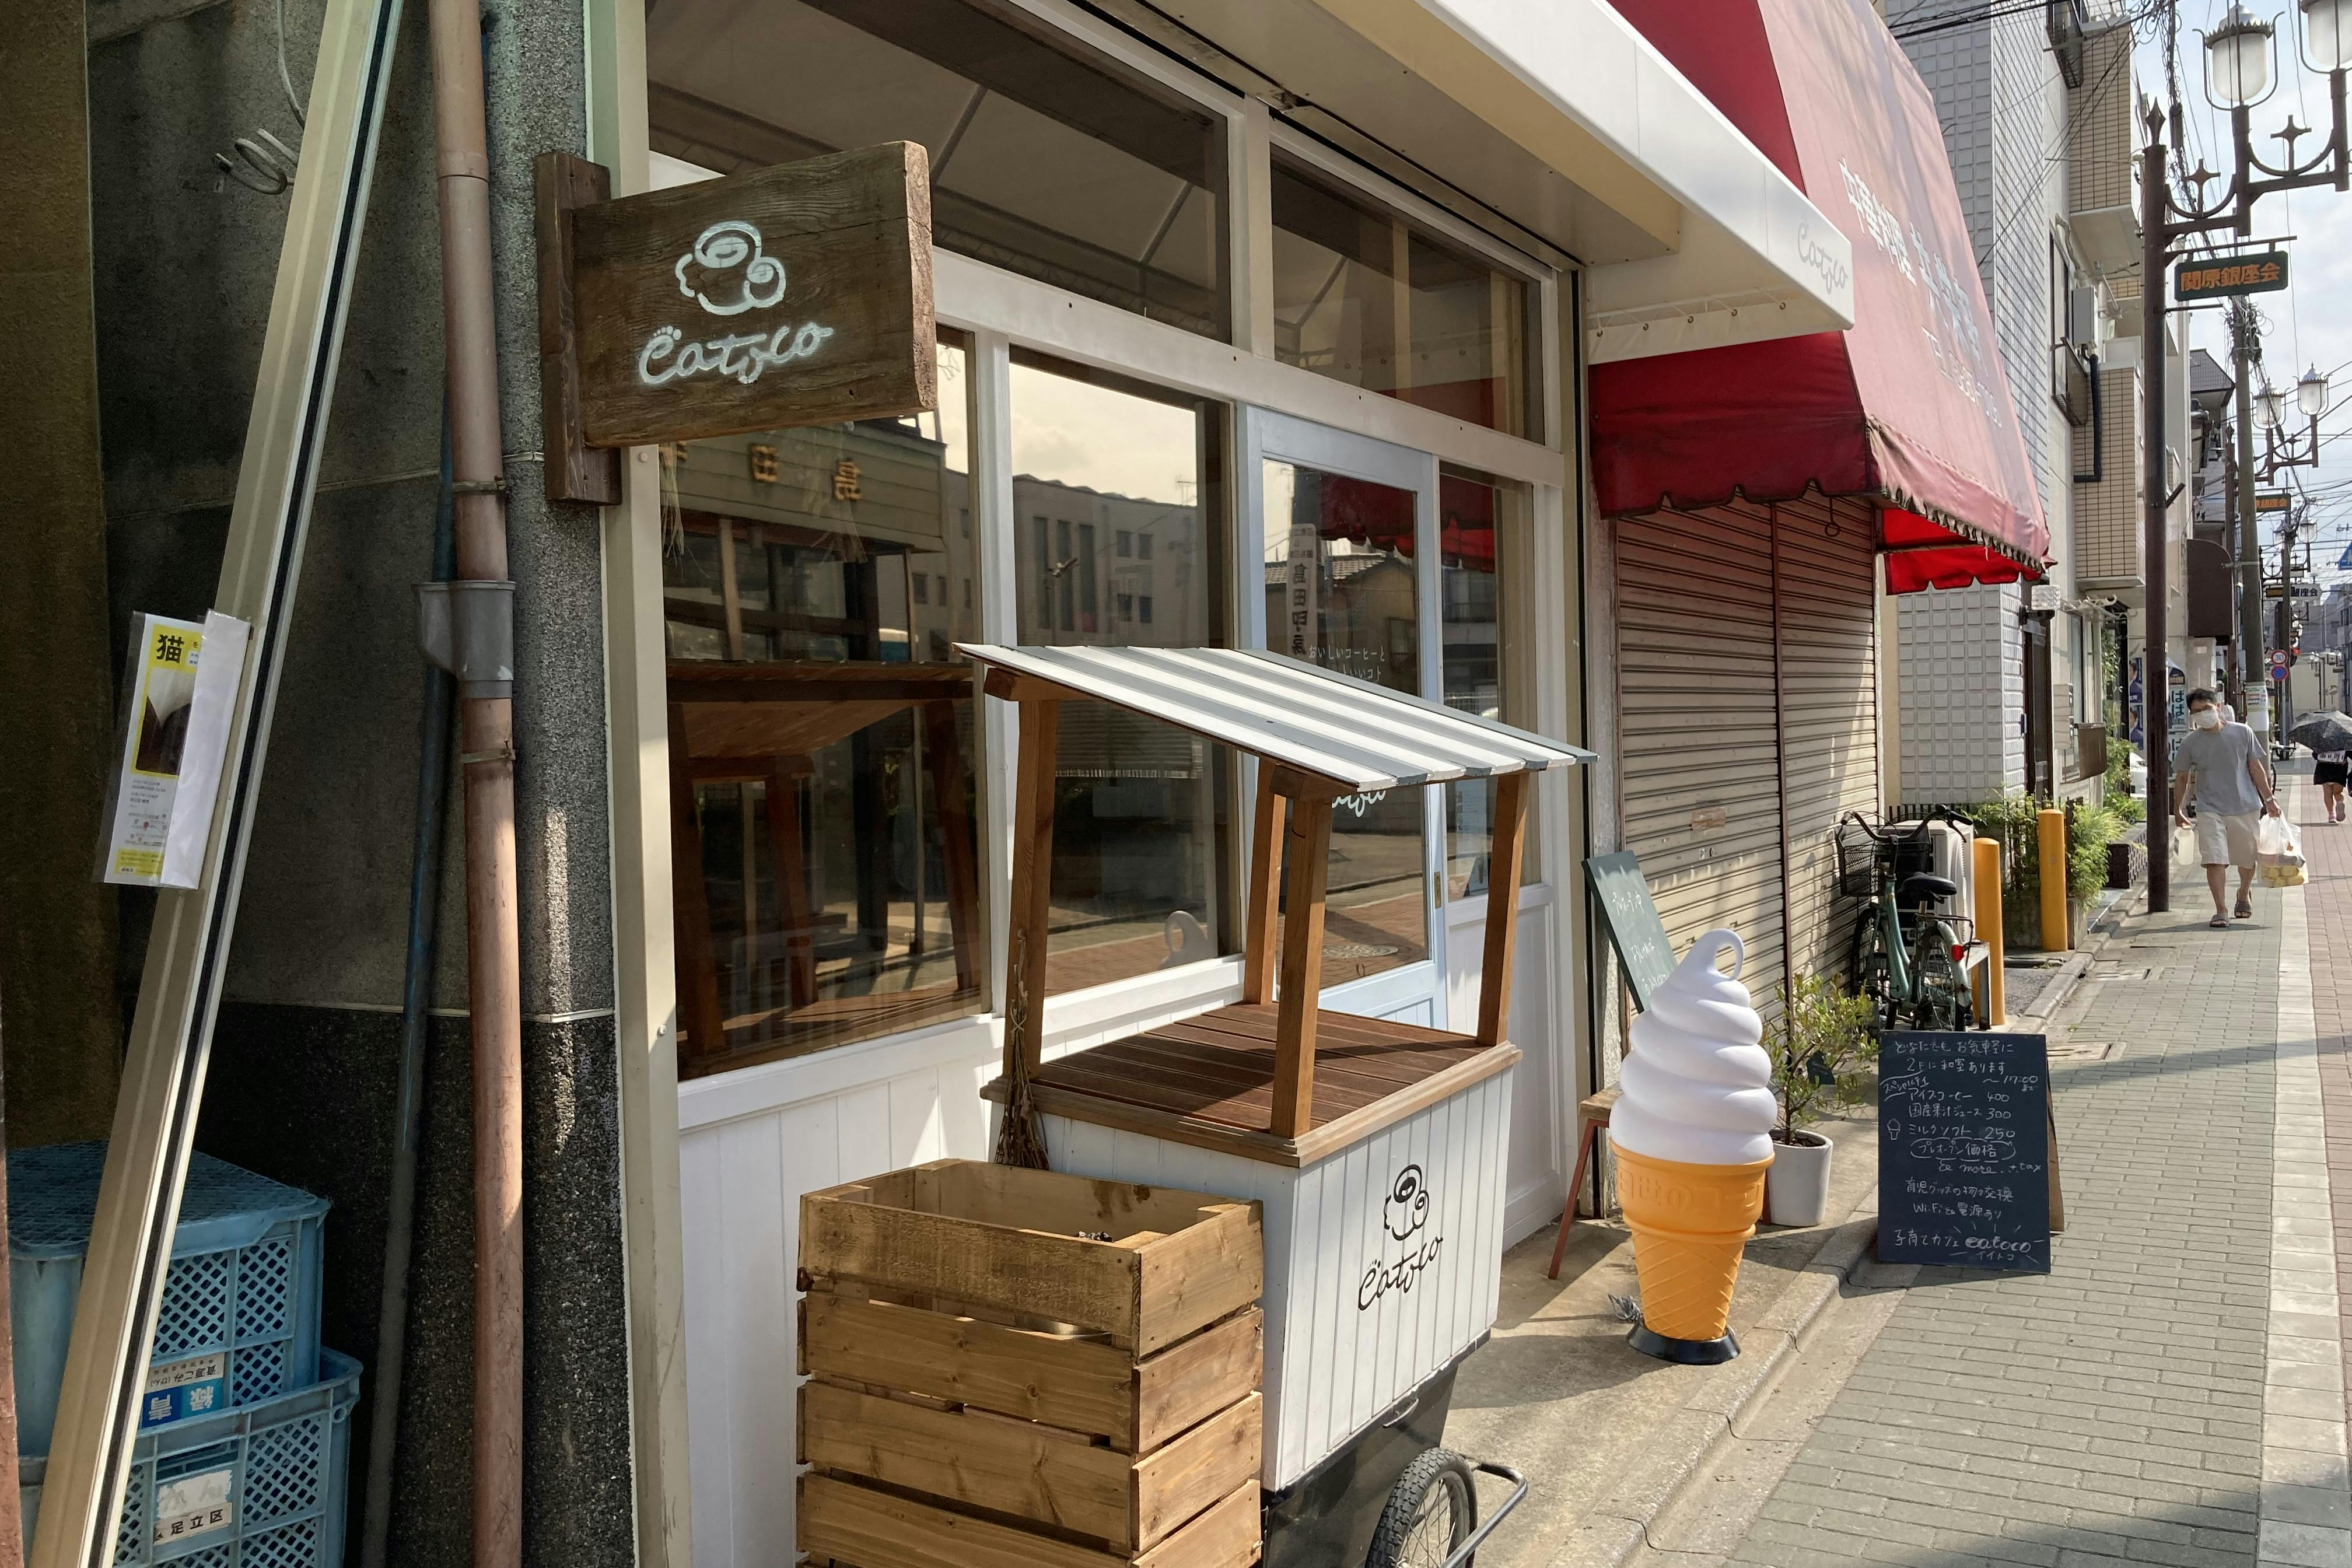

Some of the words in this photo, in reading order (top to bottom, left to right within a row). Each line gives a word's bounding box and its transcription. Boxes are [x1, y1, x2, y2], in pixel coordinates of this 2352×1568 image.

[2180, 262, 2281, 292] 関原銀座会
[156, 634, 184, 664] 猫
[1955, 1038, 2014, 1055] お気軽に
[1986, 1091, 2010, 1102] 400
[1909, 1102, 1983, 1118] 国産果汁ジュース
[1986, 1108, 2012, 1119] 300
[1908, 1124, 1971, 1137] ミルクソフト
[1985, 1126, 2016, 1140] 250
[1894, 1228, 1959, 1248] 子育てカフェ
[170, 1508, 224, 1536] 足立区
